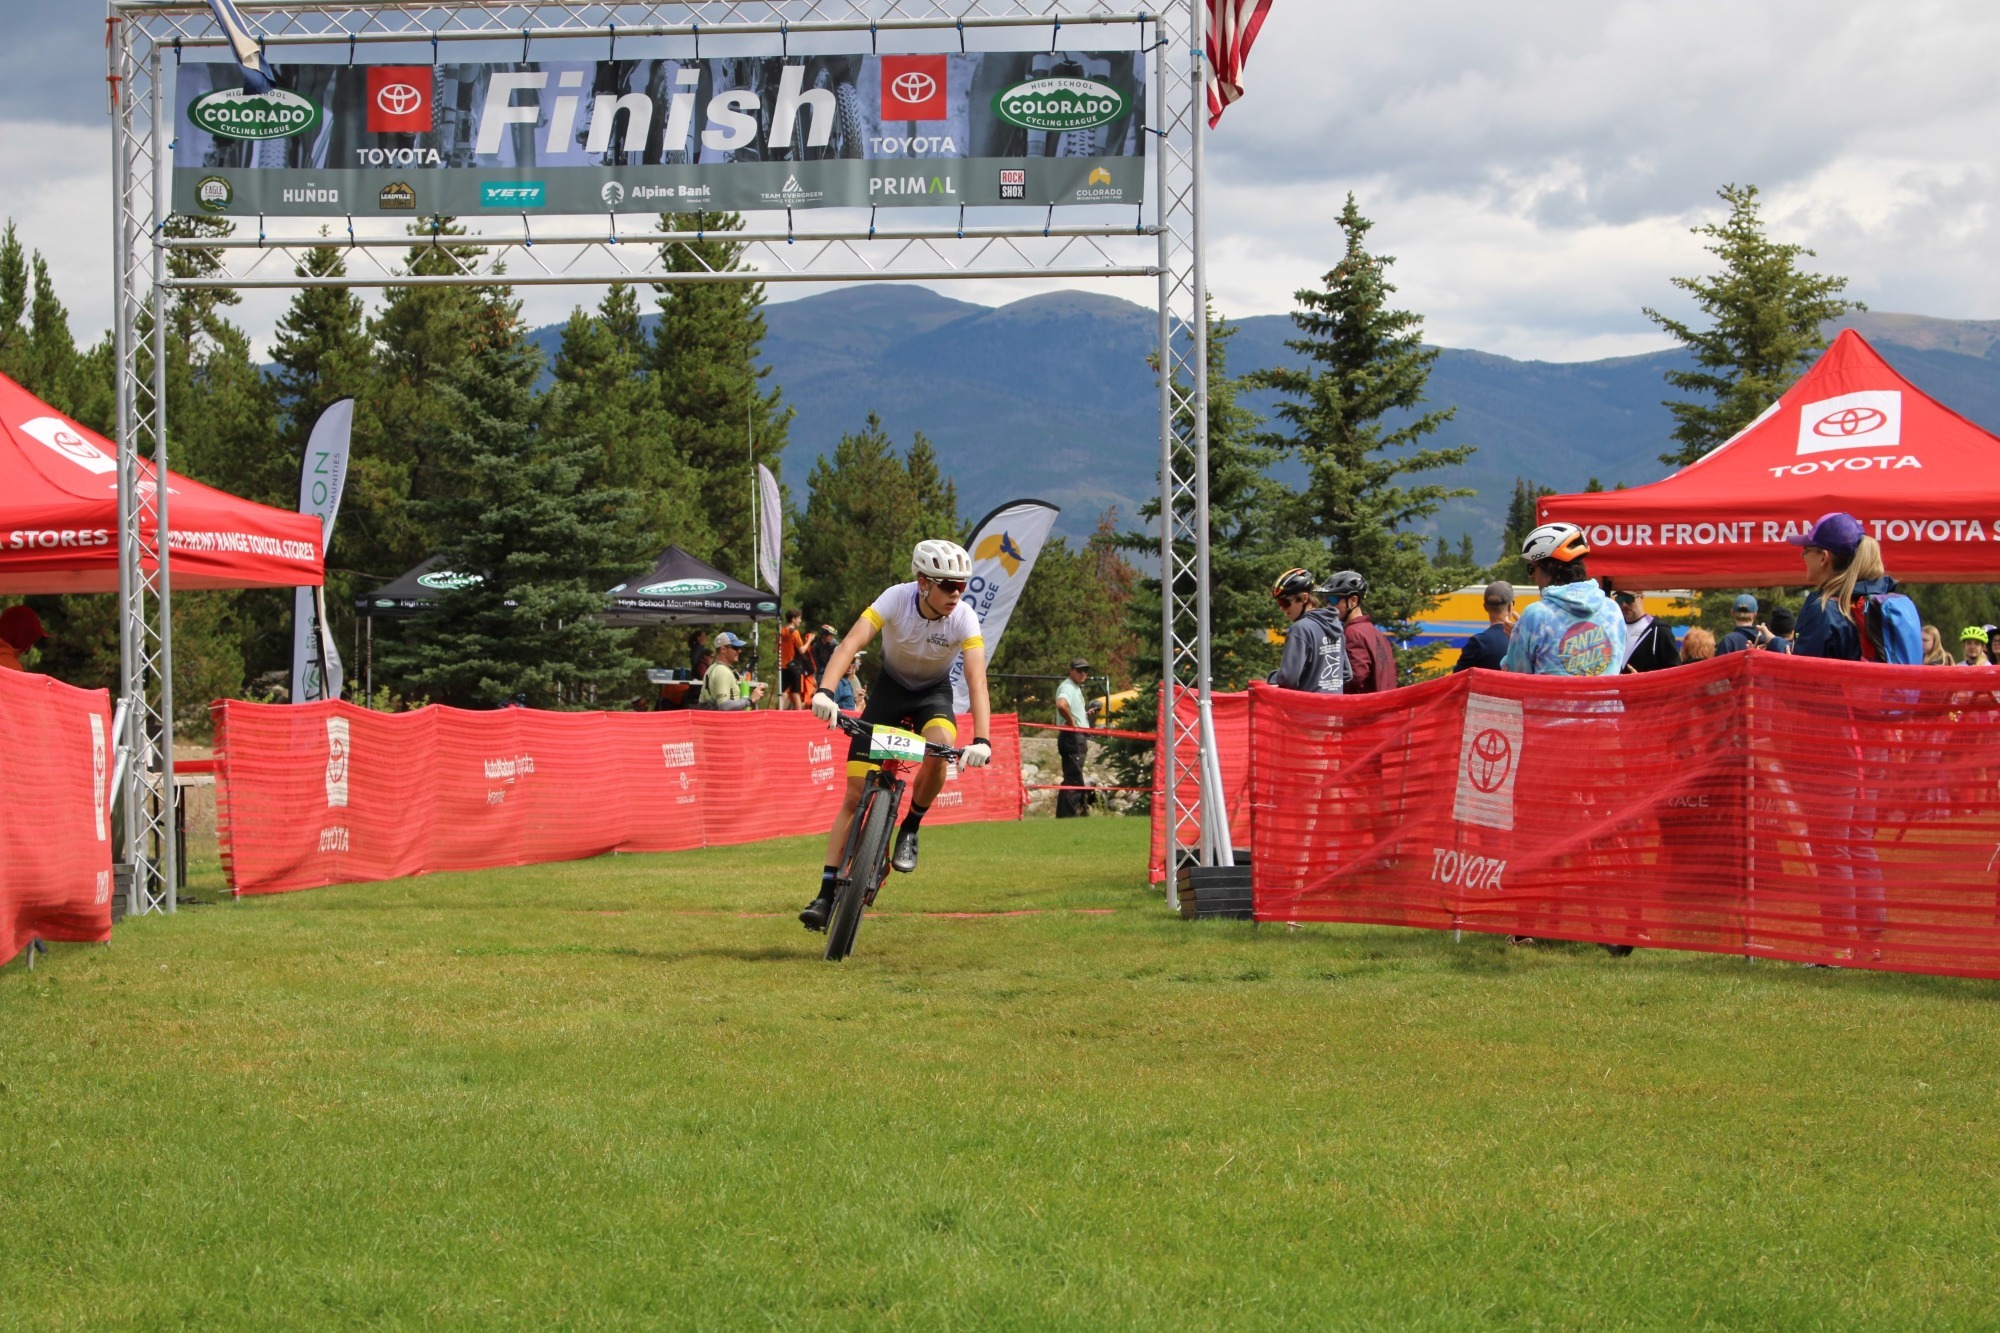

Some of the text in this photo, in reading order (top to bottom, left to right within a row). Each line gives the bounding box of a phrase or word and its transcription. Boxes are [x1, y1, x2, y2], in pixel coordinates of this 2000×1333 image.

[1031, 80, 1093, 90] HIGH SCHOOL
[475, 65, 837, 154] Finish
[1009, 100, 1113, 114] COLORADO
[204, 109, 305, 123] COLORADO
[1026, 115, 1098, 127] CYCLING LEAGUE
[220, 124, 290, 135] CYCLING LEAGUE
[870, 137, 956, 154] TOYOTA
[356, 148, 442, 165] TOYOTA
[1002, 172, 1023, 183] ROCK
[205, 185, 223, 195] EAGLE
[283, 189, 338, 203] HUNDO
[486, 188, 540, 197] YETI
[632, 185, 711, 199] Alpine Bank
[1002, 186, 1023, 198] SHOX
[1076, 188, 1123, 197] COLORADO
[1768, 455, 1923, 478] TOYOTA
[10, 529, 109, 549] STORES
[1660, 521, 1756, 545] FRONT
[1870, 519, 1986, 542] TOYOTA
[184, 531, 215, 550] FRONT
[217, 532, 249, 553] RANGE
[247, 535, 282, 557] TOYOTA
[282, 541, 315, 561] STORES
[651, 584, 715, 595] COLORADO
[618, 599, 636, 608] High
[723, 601, 751, 611] Racing
[1557, 626, 1606, 657] SANTA
[1568, 643, 1607, 672] CRUZ
[886, 735, 911, 748] 123
[808, 736, 832, 764] Corwin
[936, 791, 963, 808] TOYOTA
[318, 826, 349, 852] TOYOTA
[1431, 847, 1507, 891] TOYOTA
